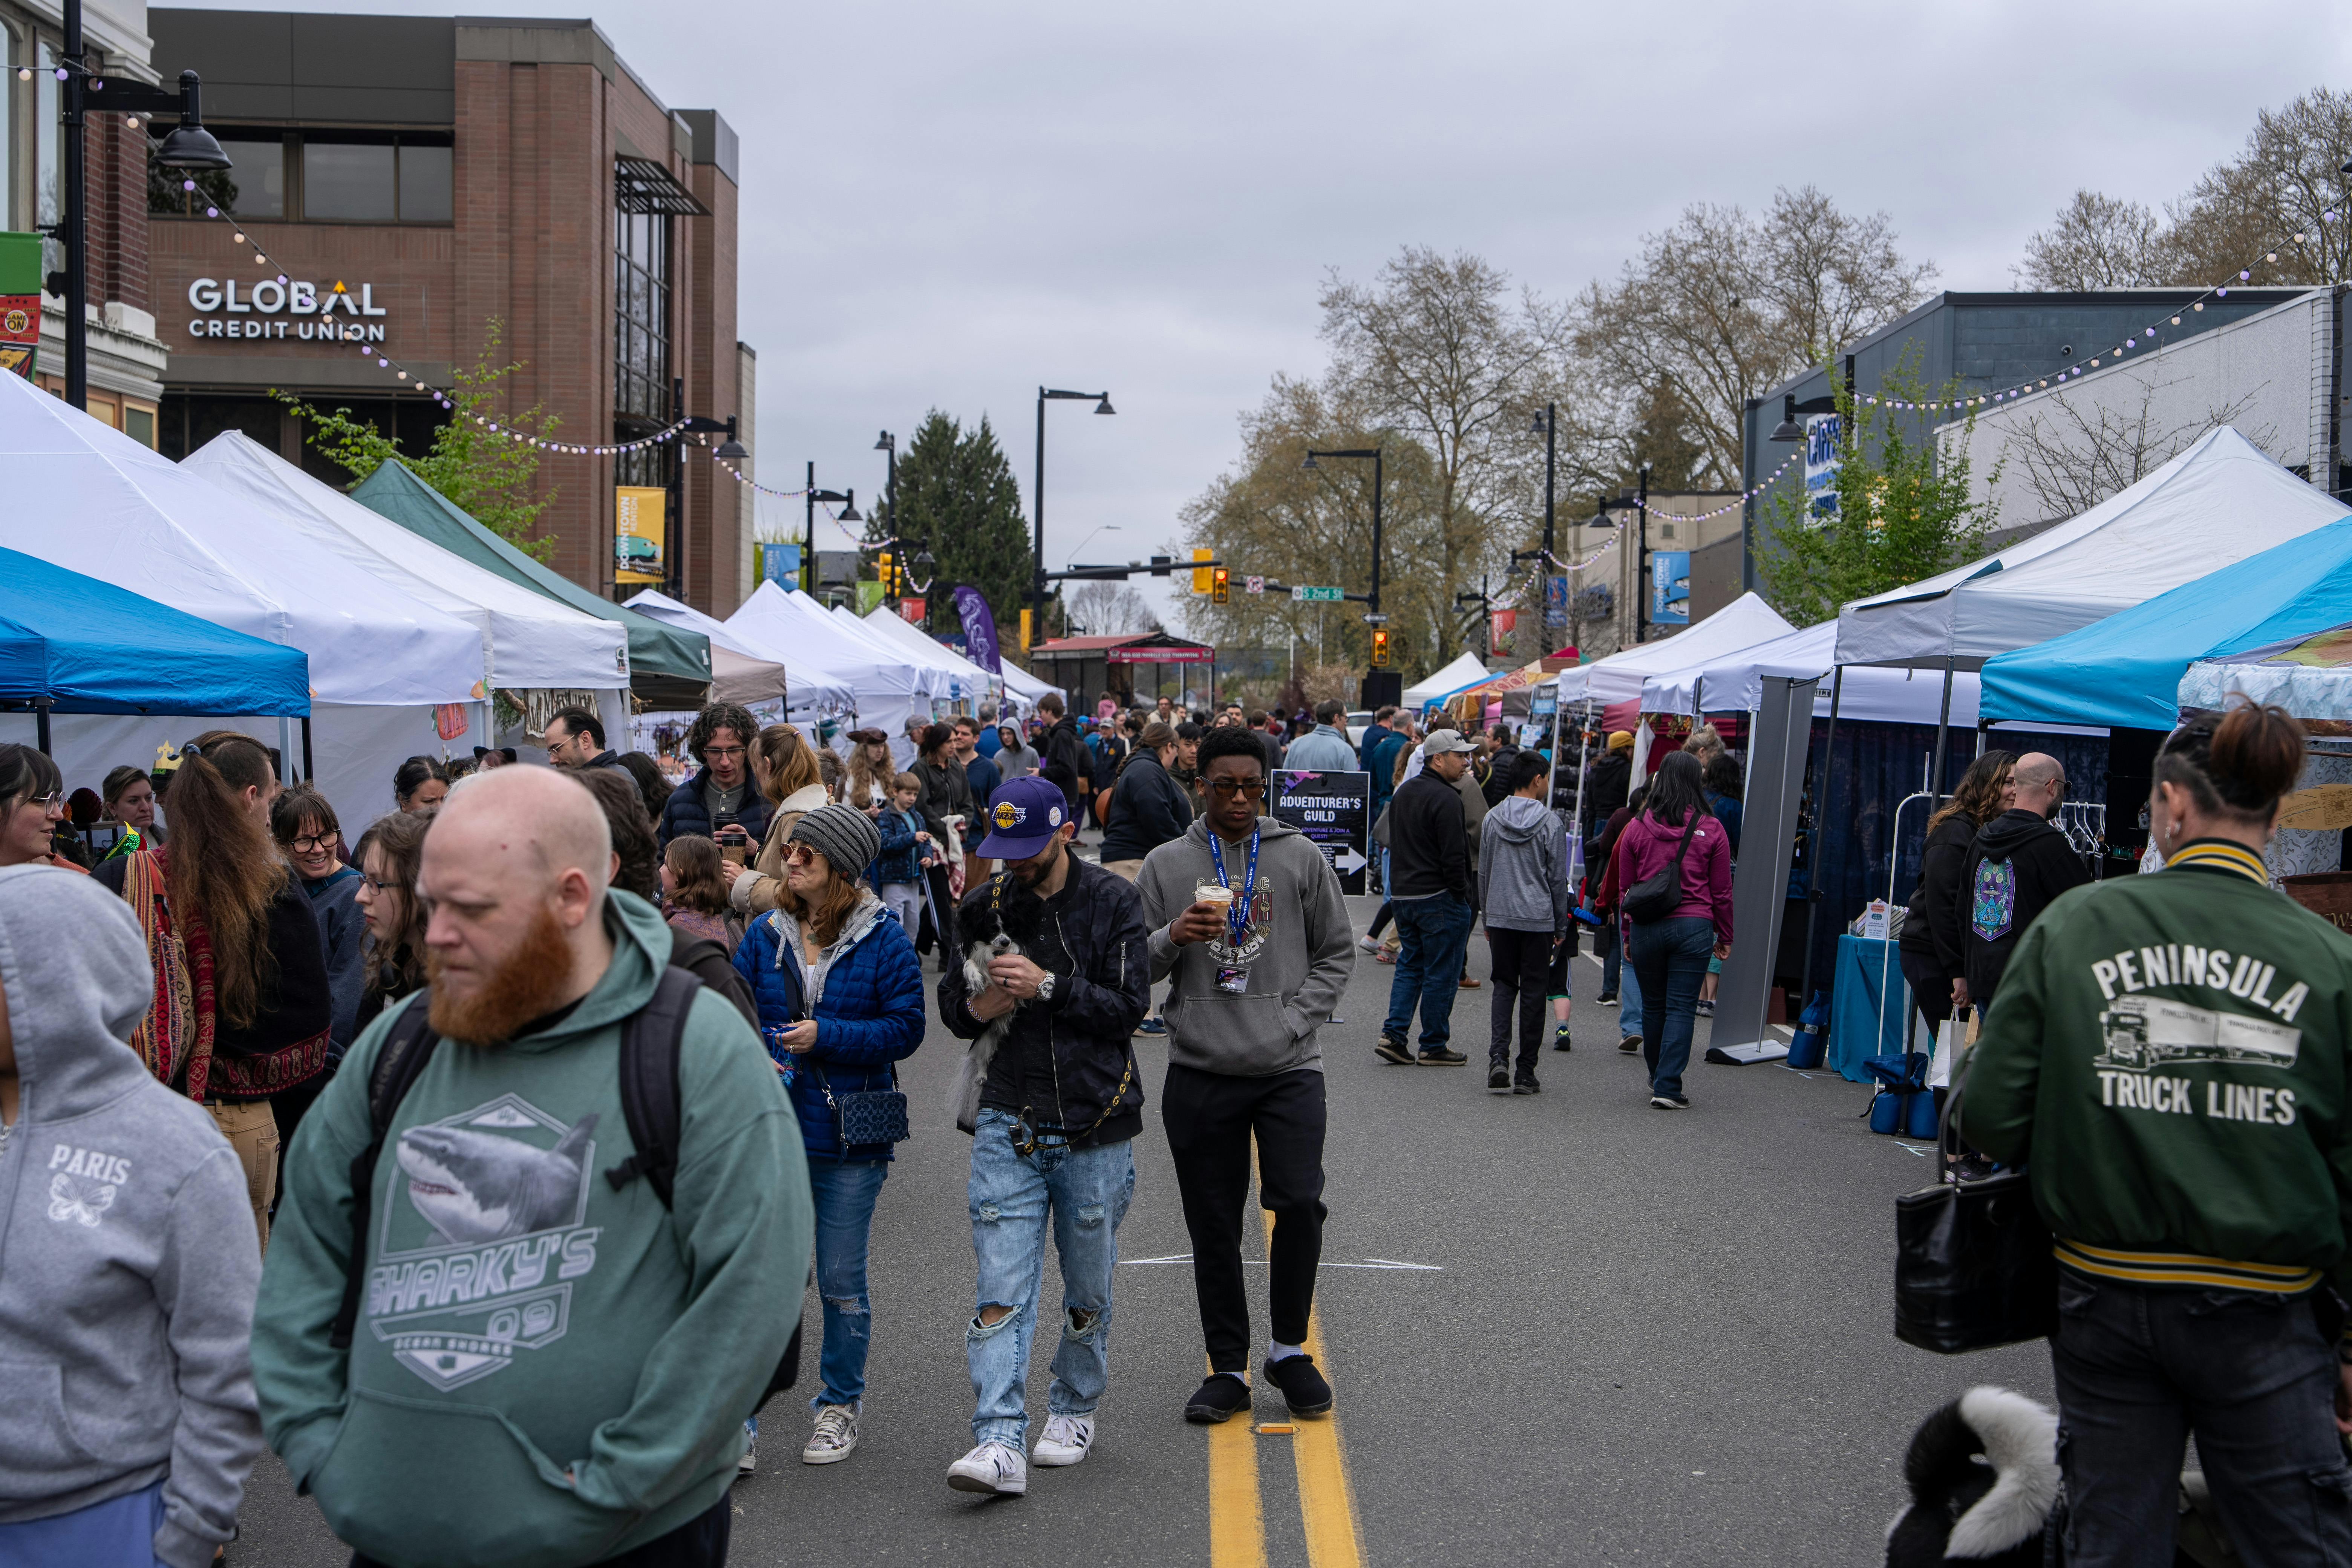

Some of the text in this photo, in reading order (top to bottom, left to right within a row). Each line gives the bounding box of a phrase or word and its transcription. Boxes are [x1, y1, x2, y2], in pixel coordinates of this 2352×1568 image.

[189, 278, 386, 315] GLOBAL
[8, 321, 24, 330] ON
[189, 319, 384, 341] CREDIT UNION
[620, 496, 630, 570] DOWNTOWN
[1304, 588, 1342, 598] S 2nd St
[1279, 796, 1361, 809] ADVENTURER'S
[1304, 810, 1335, 822] GUILD
[1218, 867, 1227, 888] Volunteer
[1260, 877, 1269, 890] C
[1208, 951, 1222, 962] BLACK
[1246, 952, 1261, 963] UNION
[2091, 944, 2309, 1022] PENINSULA
[2097, 1071, 2296, 1125] TRUCK LINES
[47, 1144, 133, 1185] PARIS
[367, 1227, 599, 1315] SHARKY'S
[487, 1299, 556, 1341] 09
[394, 1337, 513, 1356] OCEAN SHORES
